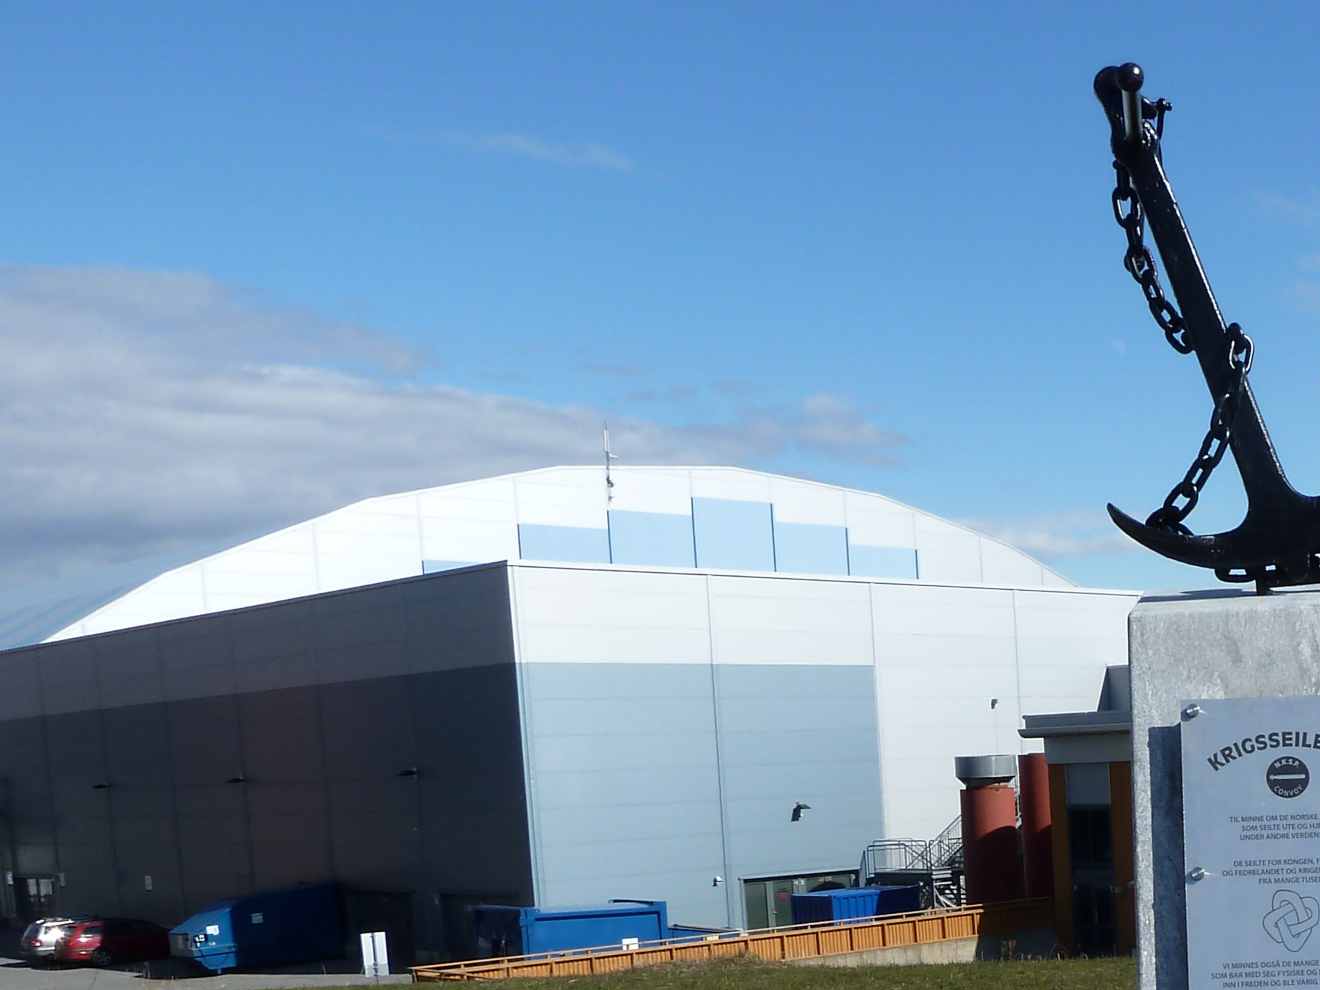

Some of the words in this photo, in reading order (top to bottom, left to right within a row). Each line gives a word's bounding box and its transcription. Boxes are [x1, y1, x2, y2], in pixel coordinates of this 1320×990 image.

[1240, 833, 1264, 841] UNDER
[1266, 832, 1290, 840] ANDRE
[1267, 858, 1281, 866] FOR
[1293, 959, 1320, 967] MANGE
[1211, 972, 1227, 980] SOM
[1262, 970, 1276, 978] SEG
[1271, 979, 1281, 987] OG
[1296, 977, 1318, 985] VARIG
